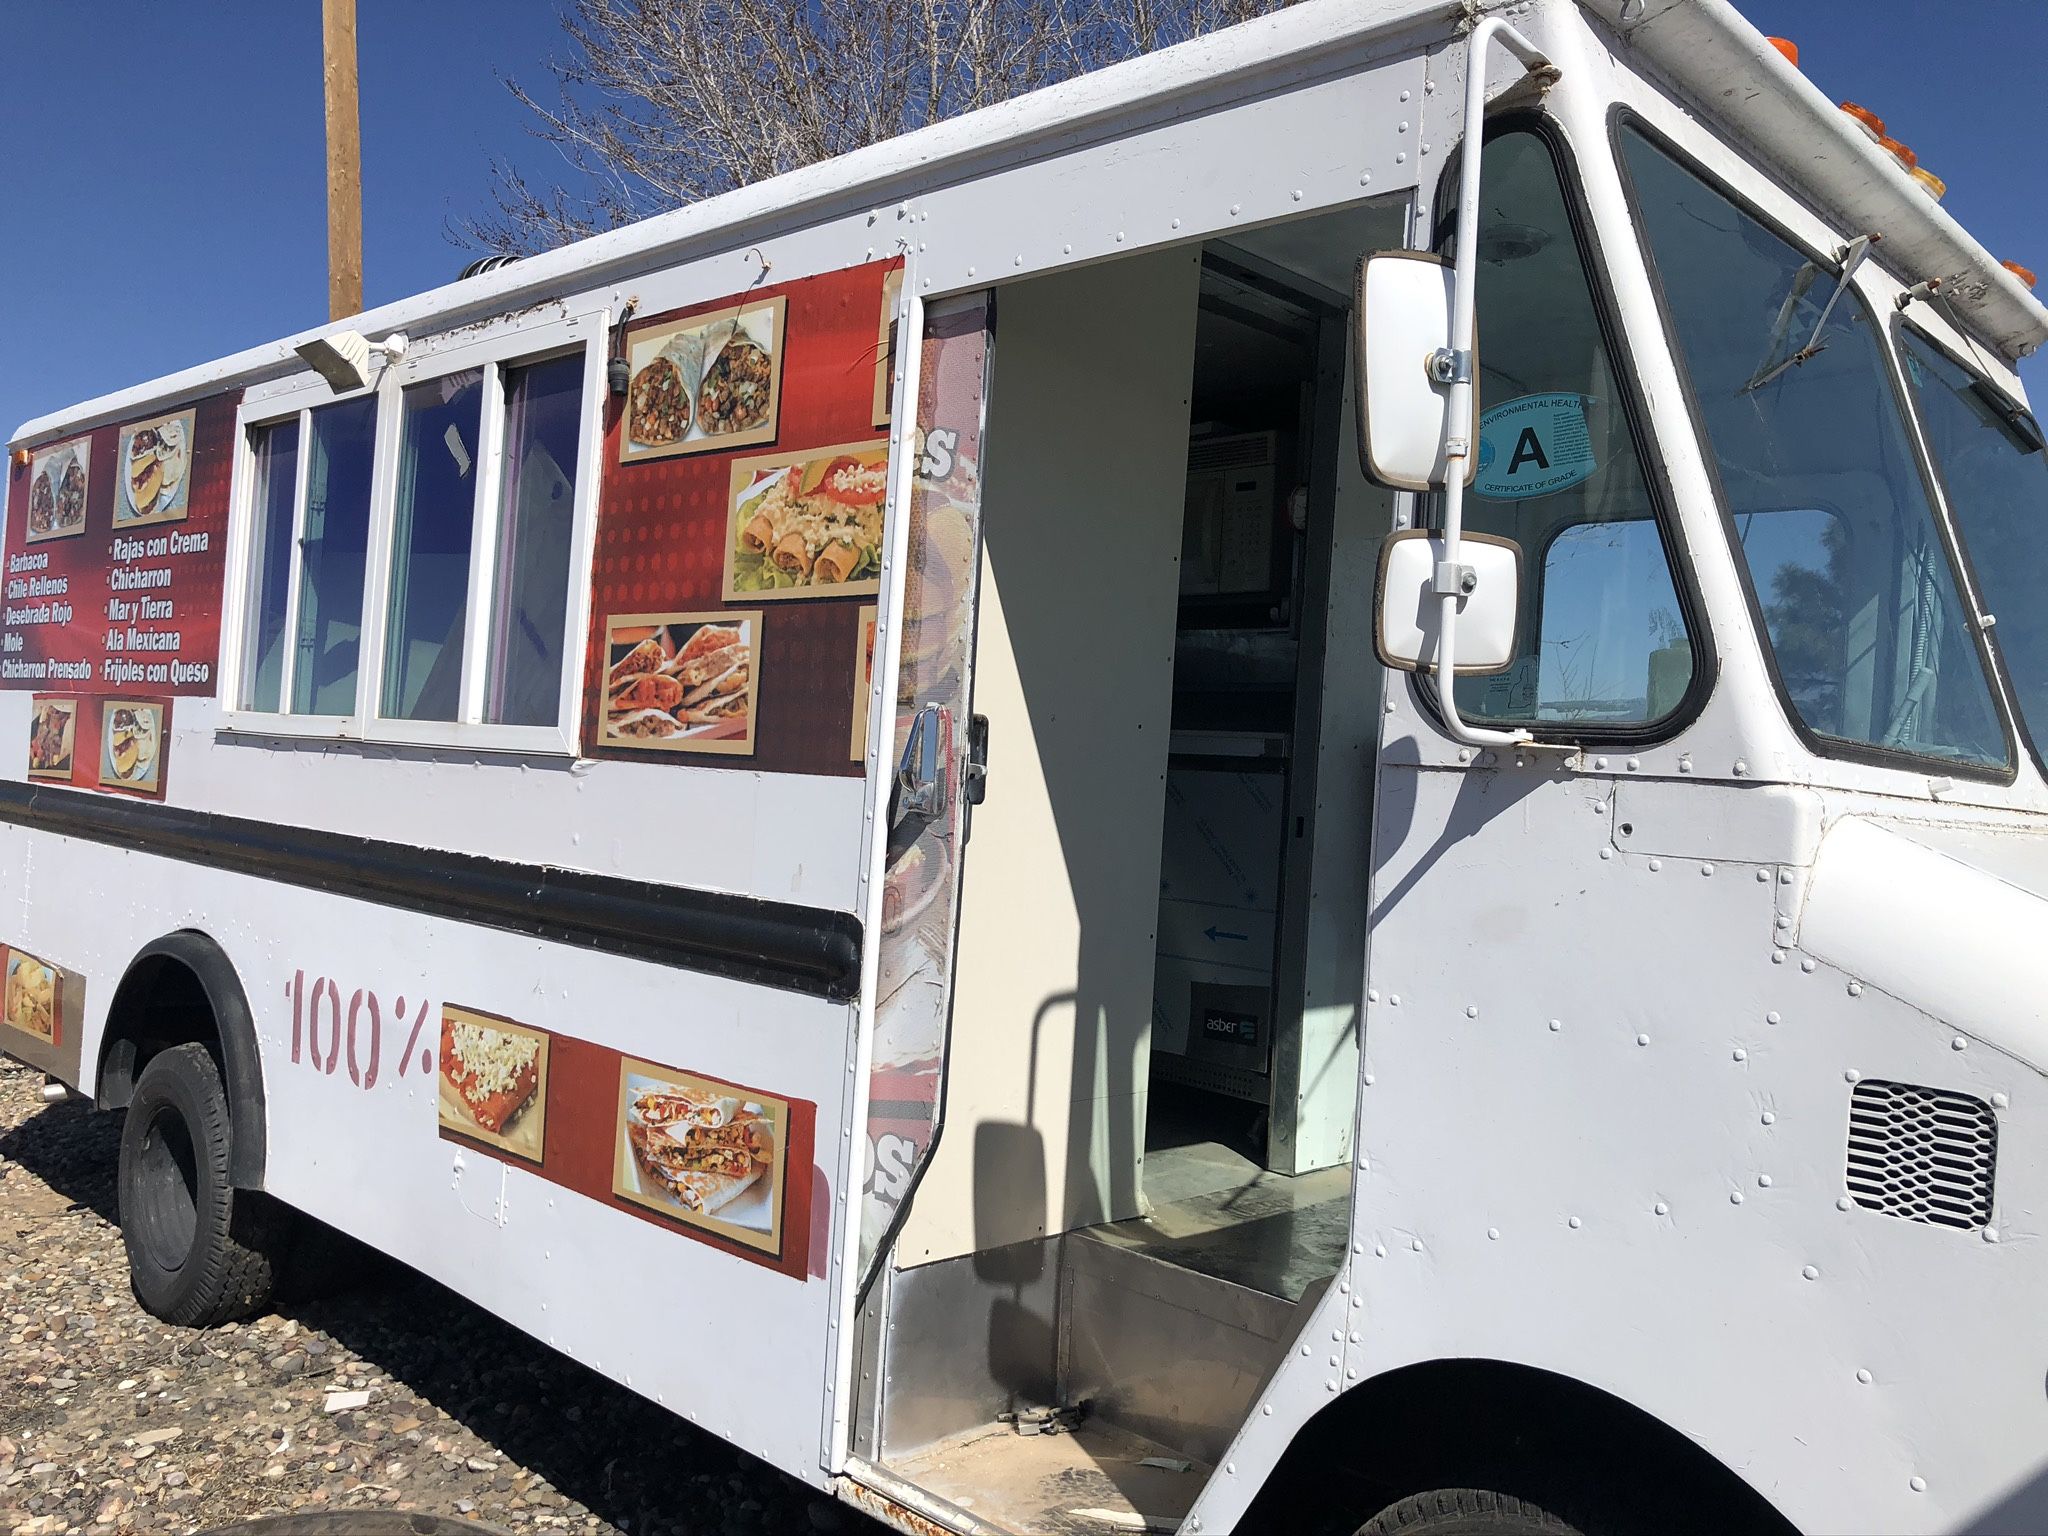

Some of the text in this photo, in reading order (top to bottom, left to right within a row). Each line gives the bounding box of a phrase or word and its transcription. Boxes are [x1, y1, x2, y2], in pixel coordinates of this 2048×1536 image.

[1480, 400, 1549, 430] ENVIRONMENTAL
[1507, 426, 1550, 475] A
[1484, 469, 1577, 492] CERTIFICATE OF GRADE
[113, 530, 209, 564] Rajas con Crema
[10, 551, 48, 573] Barbacoa
[8, 575, 68, 600] Chile Rellenos
[111, 567, 172, 591] Chicharron
[6, 601, 73, 627] Desebrada Rojo
[108, 595, 173, 625] Mar y Tierra
[3, 632, 23, 652] Mole
[105, 627, 181, 651] Ala Mexicana
[2, 658, 92, 680] Chicharron Prensado
[104, 659, 209, 686] Frijoles con Queso
[285, 969, 432, 1090] 100%
[1206, 1018, 1238, 1034] asber
